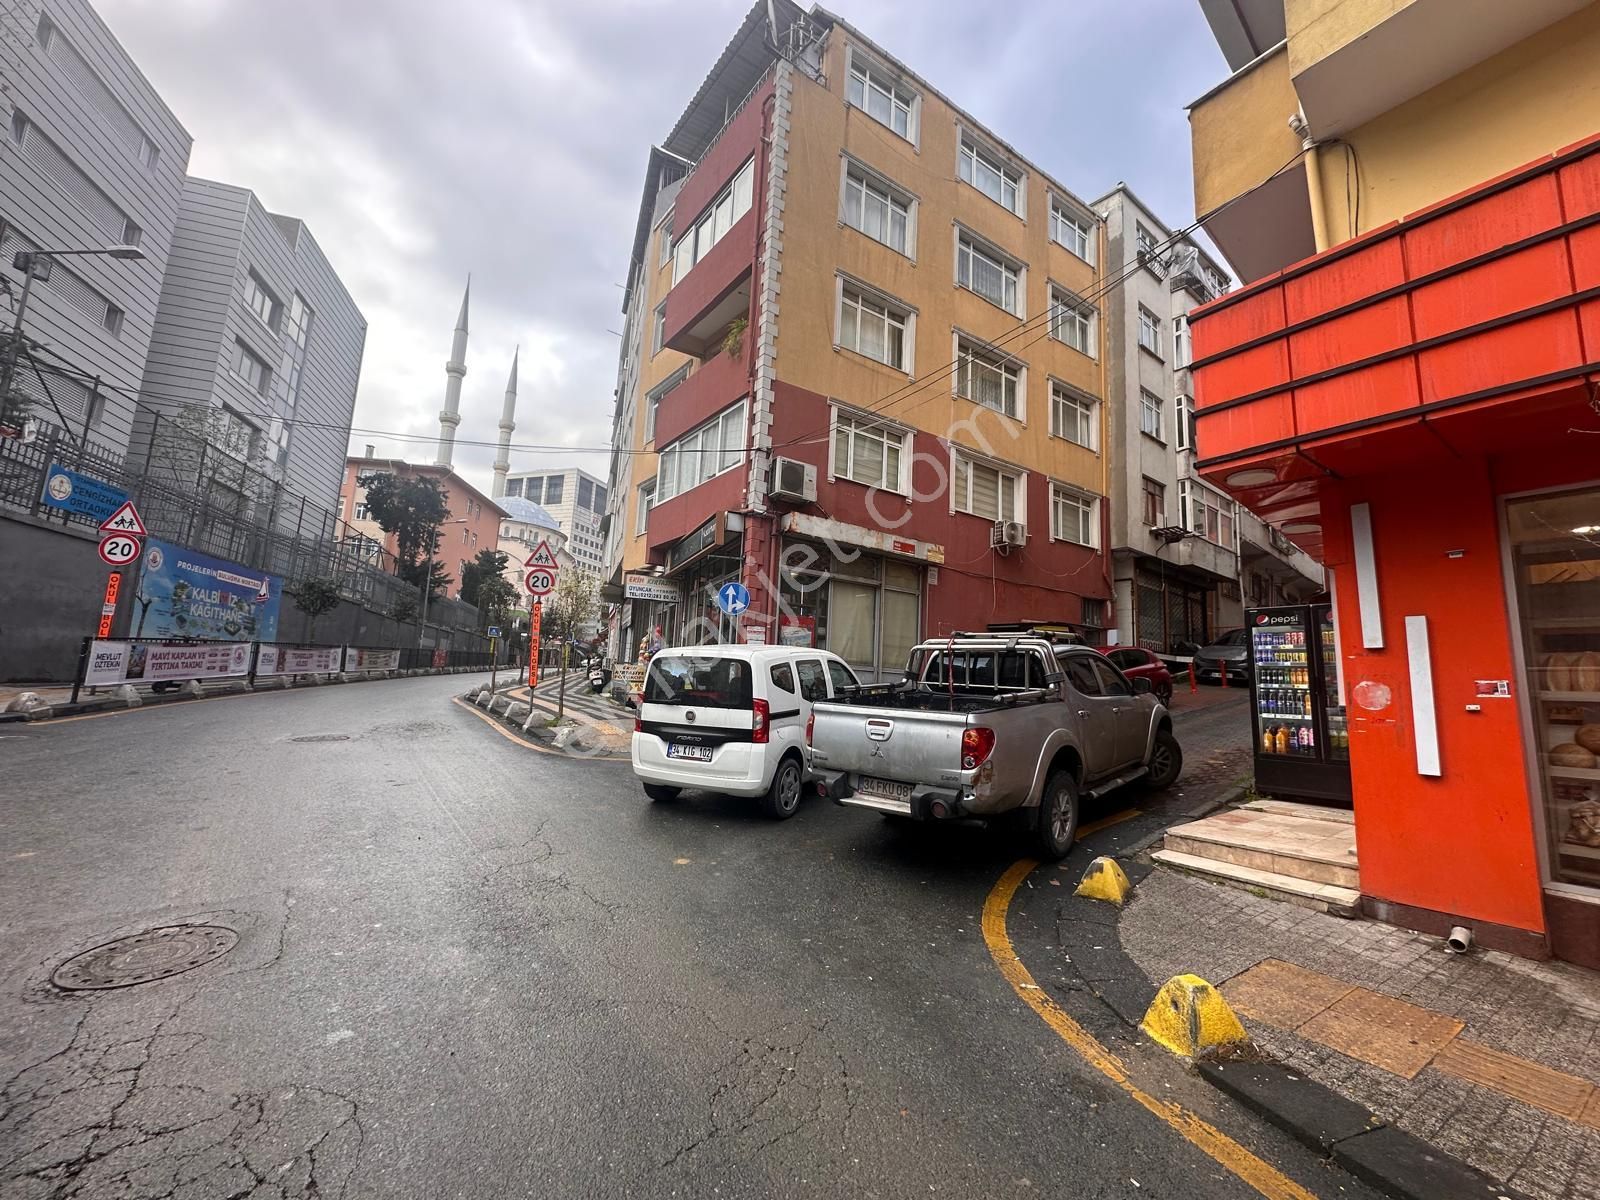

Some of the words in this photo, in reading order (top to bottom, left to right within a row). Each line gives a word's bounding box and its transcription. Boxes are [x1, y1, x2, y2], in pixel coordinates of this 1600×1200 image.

[107, 541, 132, 557] 20
[532, 575, 549, 589] 20
[108, 576, 119, 604] OKUL
[1271, 614, 1299, 625] pepsi
[672, 744, 680, 755] 34
[700, 747, 711, 758] 102
[864, 778, 875, 791] 34
[876, 781, 895, 796] FKU
